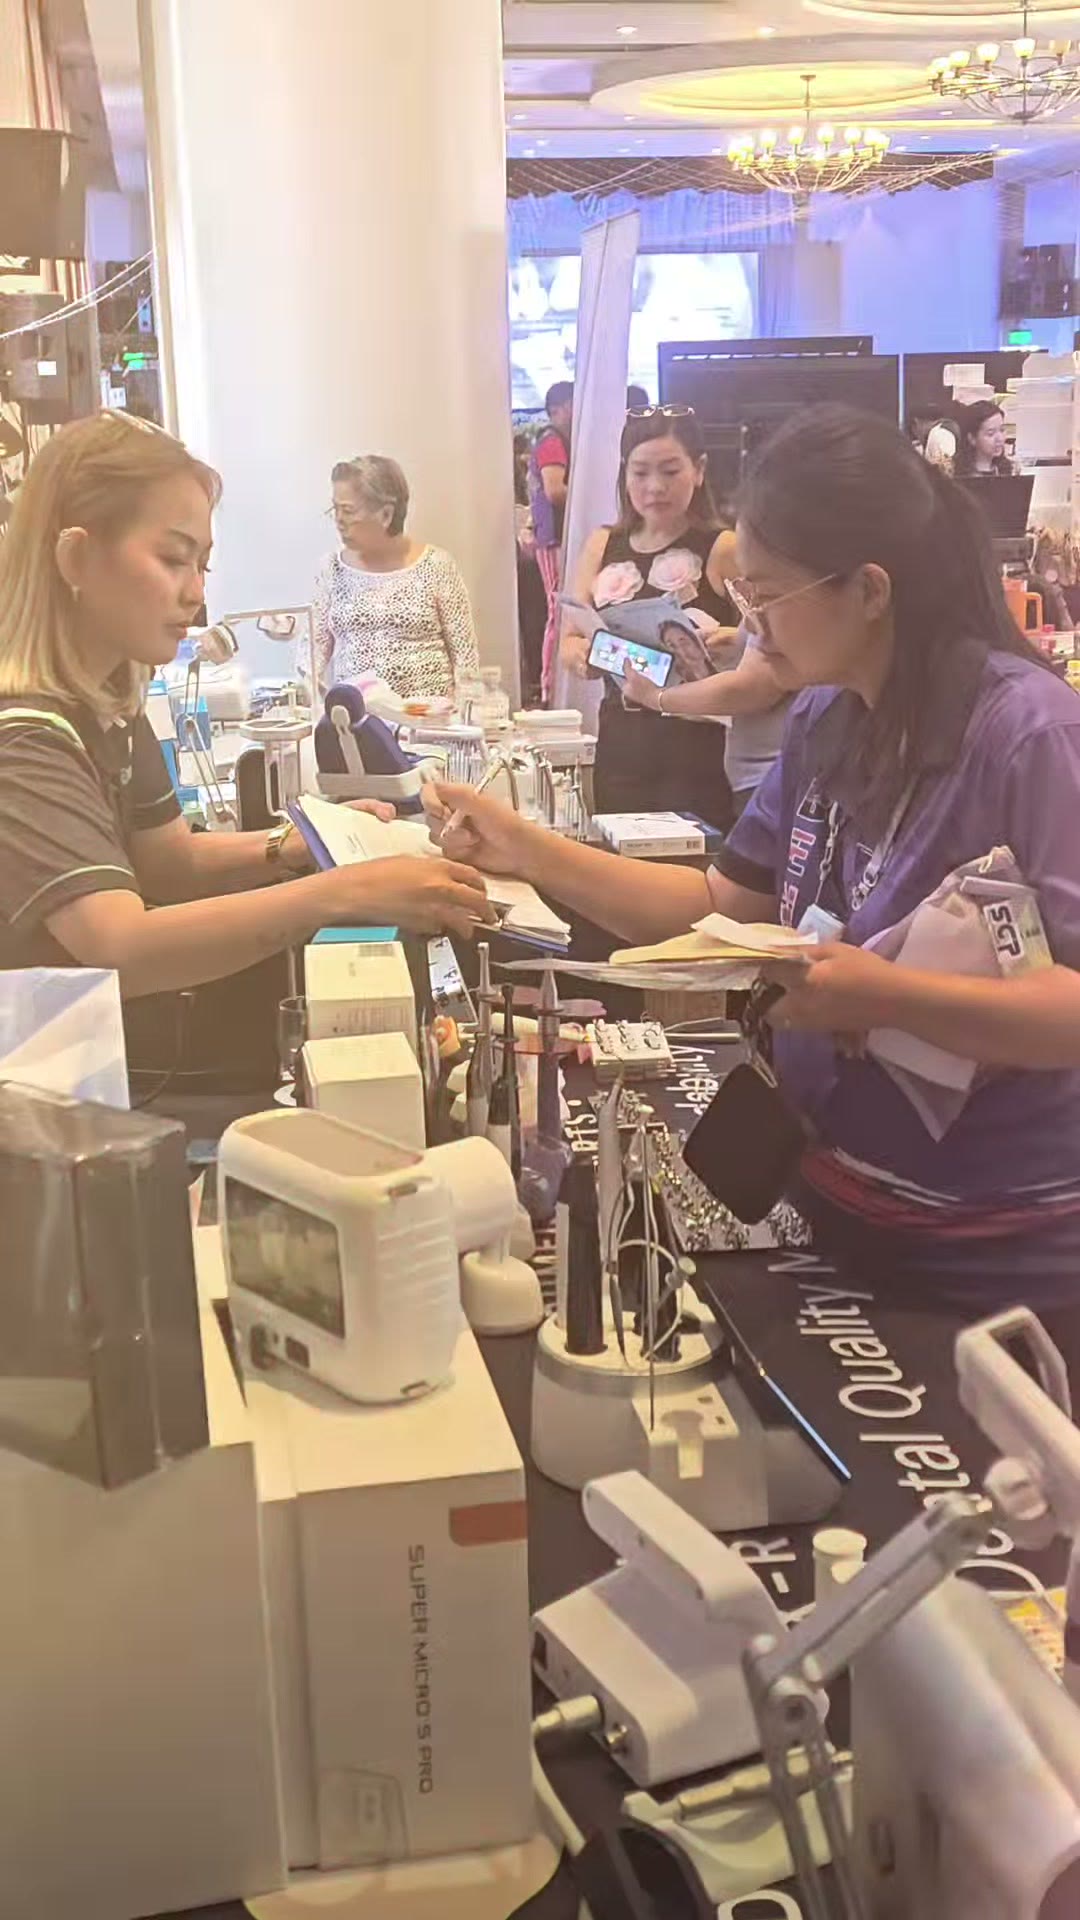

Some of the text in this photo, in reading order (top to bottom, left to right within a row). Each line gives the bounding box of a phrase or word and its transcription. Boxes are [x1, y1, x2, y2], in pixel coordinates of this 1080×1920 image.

[795, 1283, 923, 1420] Quality
[408, 1543, 428, 1635] SUPER
[413, 1641, 432, 1718] MICRO
[417, 1744, 434, 1795] PRO
